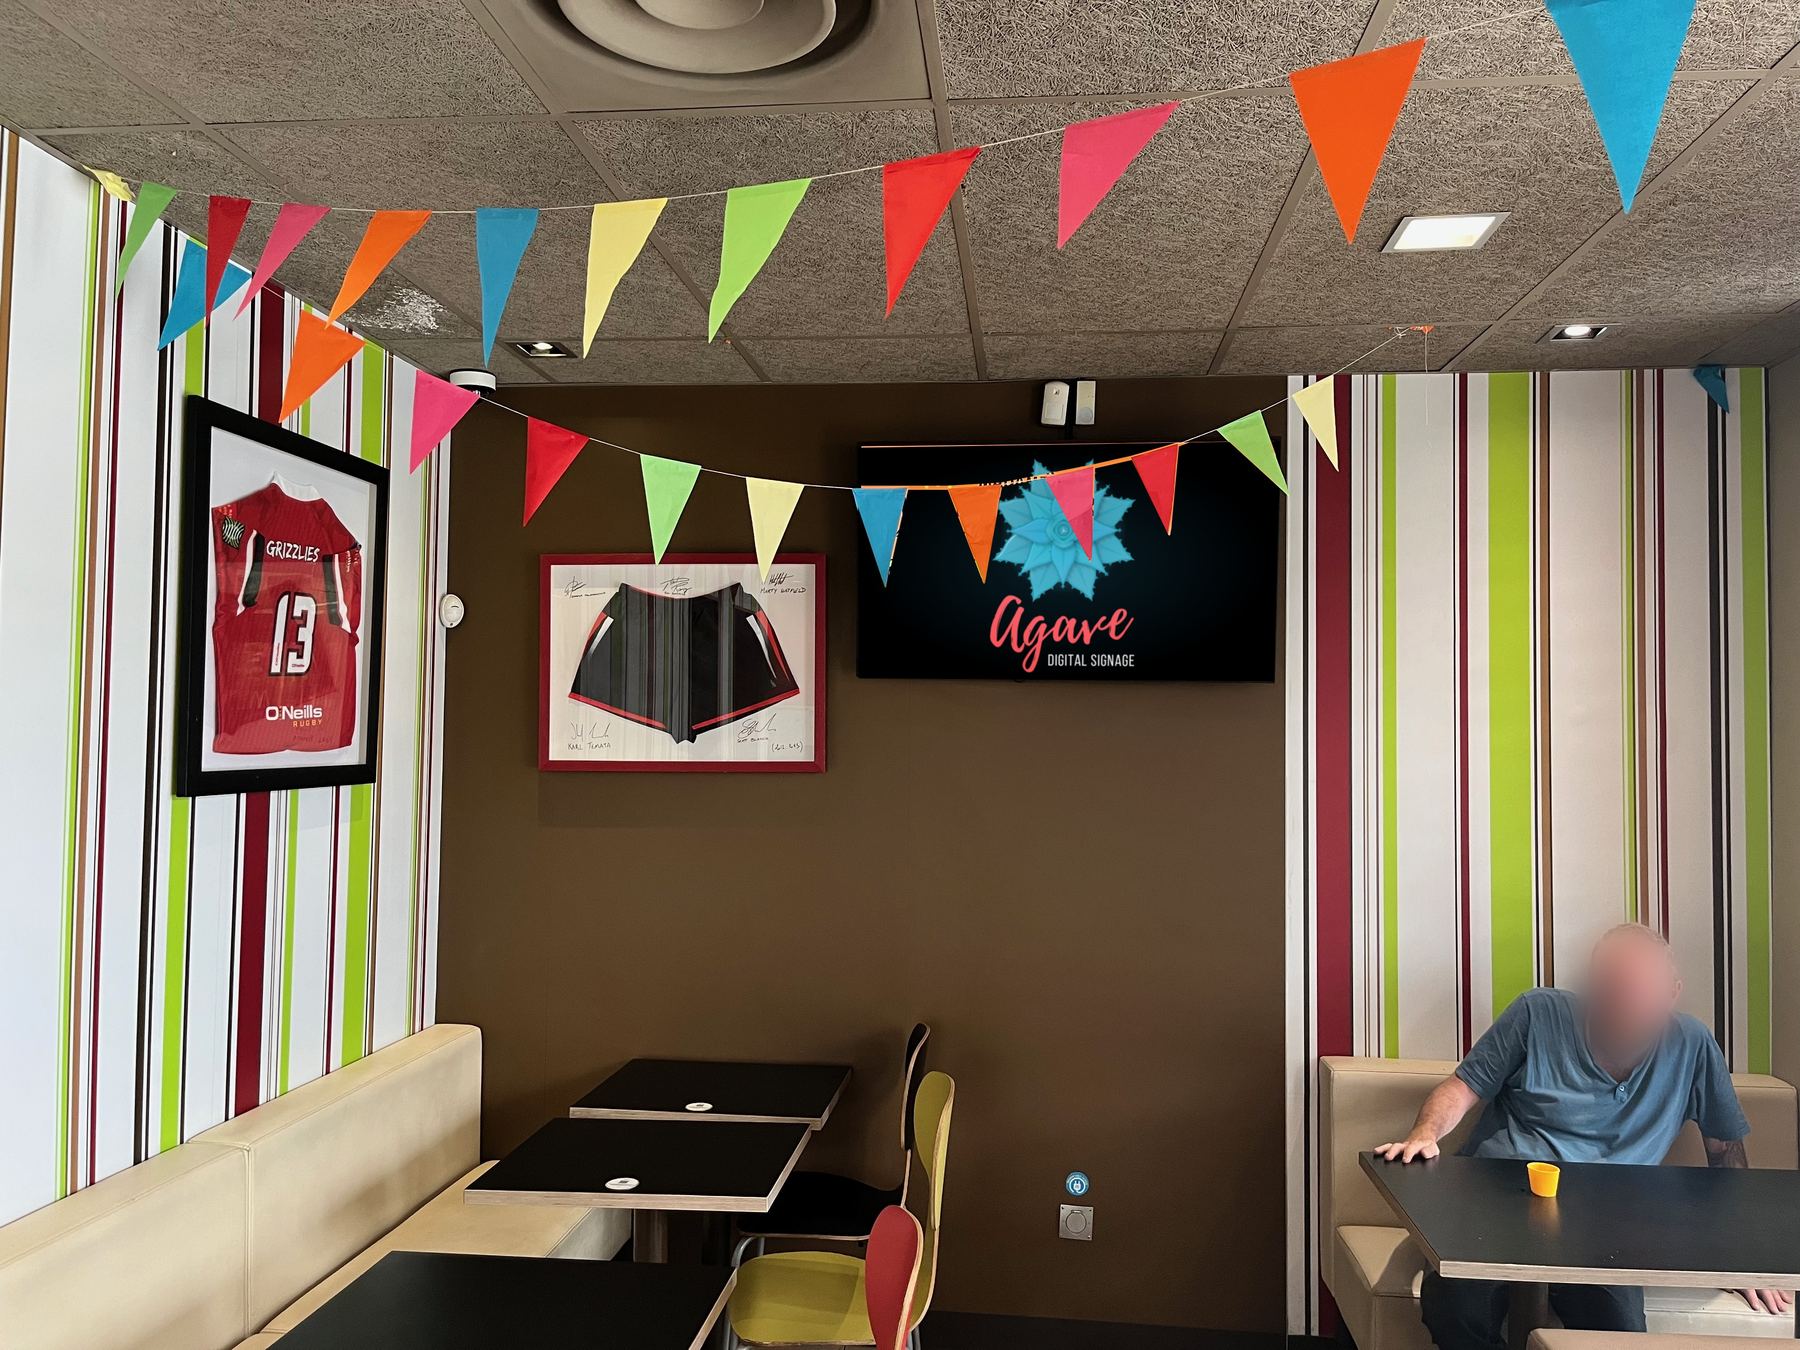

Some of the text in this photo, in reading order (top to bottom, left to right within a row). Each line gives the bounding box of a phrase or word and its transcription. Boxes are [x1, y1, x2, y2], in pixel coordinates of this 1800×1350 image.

[266, 540, 321, 563] GRIZZLIES
[270, 592, 317, 675] 13
[989, 594, 1135, 674] Agave
[1047, 653, 1135, 667] DIGITAL SIGNAGE
[265, 704, 323, 721] O'Neills
[293, 718, 323, 728] RUGBY
